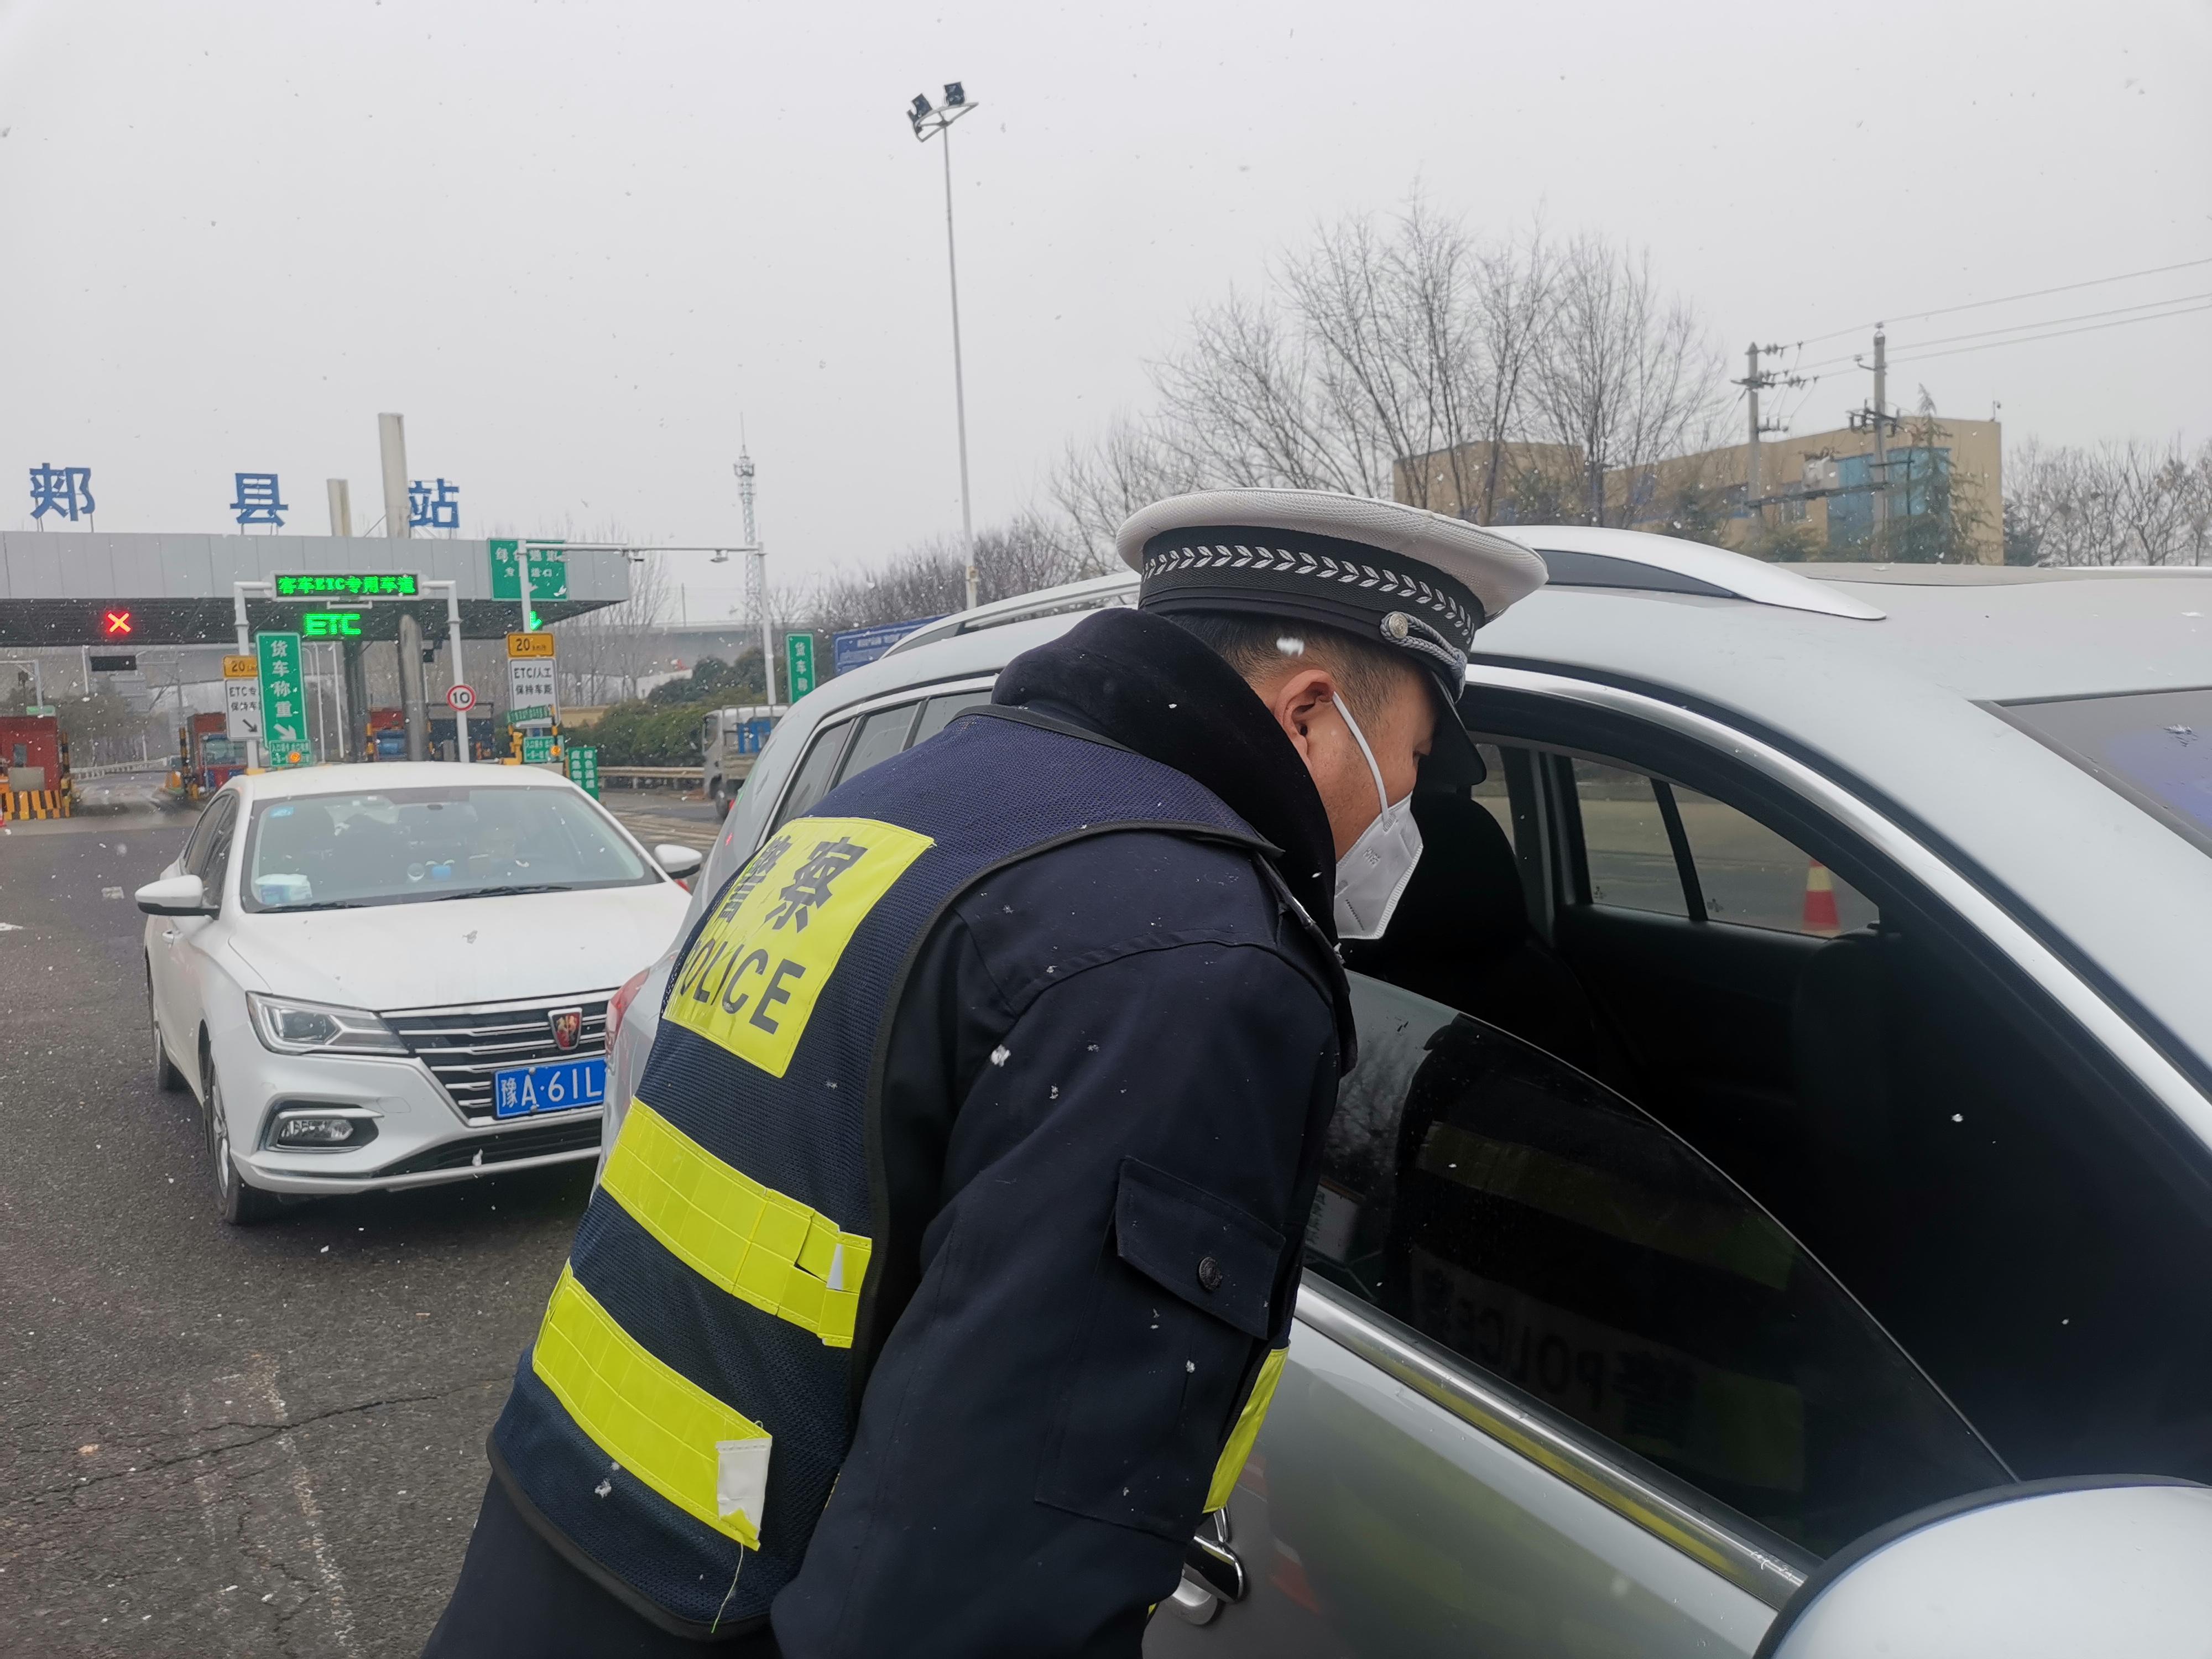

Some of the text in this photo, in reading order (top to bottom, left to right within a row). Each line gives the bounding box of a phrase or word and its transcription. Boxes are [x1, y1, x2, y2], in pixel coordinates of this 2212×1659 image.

[30, 463, 460, 529] 郏县站
[305, 613, 362, 635] ETC
[517, 638, 530, 651] 20
[231, 660, 246, 672] 20
[270, 640, 293, 718] 货车称重
[514, 667, 552, 679] ETC/人工
[515, 684, 553, 695] 保持车距
[453, 692, 470, 704] 10
[719, 834, 868, 933] 警察
